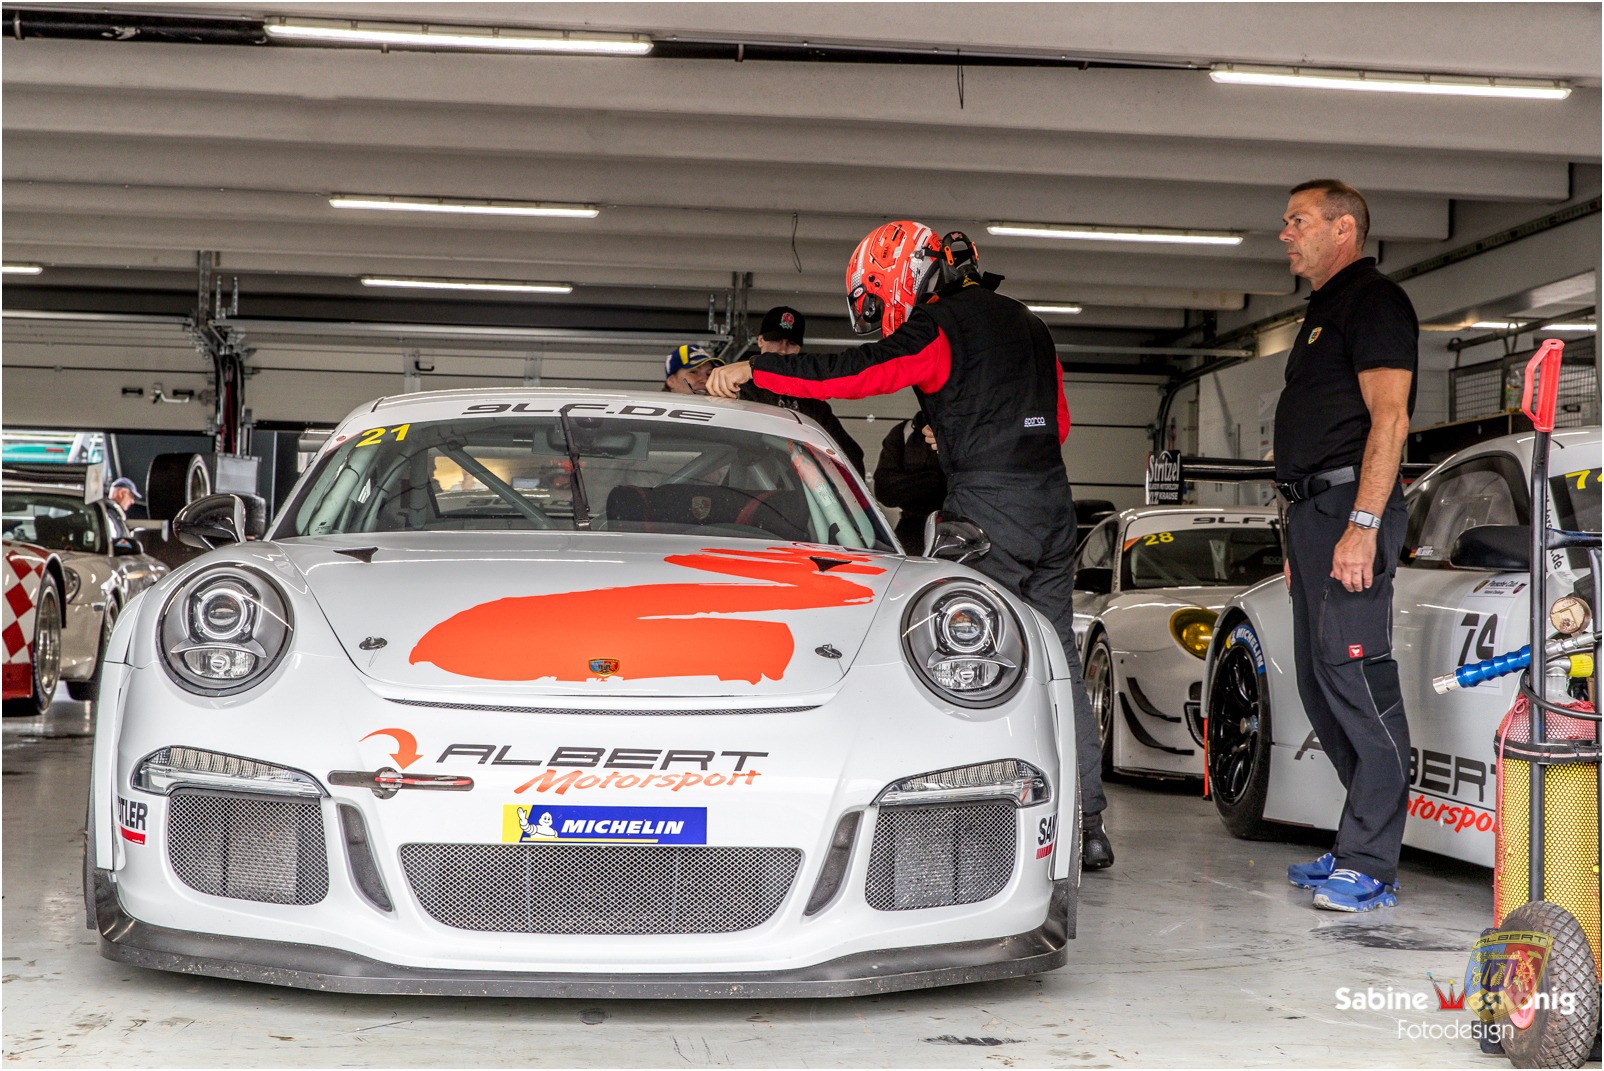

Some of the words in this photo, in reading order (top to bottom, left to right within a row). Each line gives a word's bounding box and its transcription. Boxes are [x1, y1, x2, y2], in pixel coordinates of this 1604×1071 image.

[355, 424, 411, 448] 21
[1149, 451, 1180, 482] Stritzel
[1565, 469, 1602, 490] 7
[1192, 516, 1280, 525] 9LF.
[1143, 531, 1175, 546] 28
[1236, 627, 1264, 668] MICHELIN
[436, 743, 769, 771] ALBERT
[513, 769, 762, 795] Motorsport
[117, 796, 149, 831] TLER
[560, 818, 685, 836] MICHELIN
